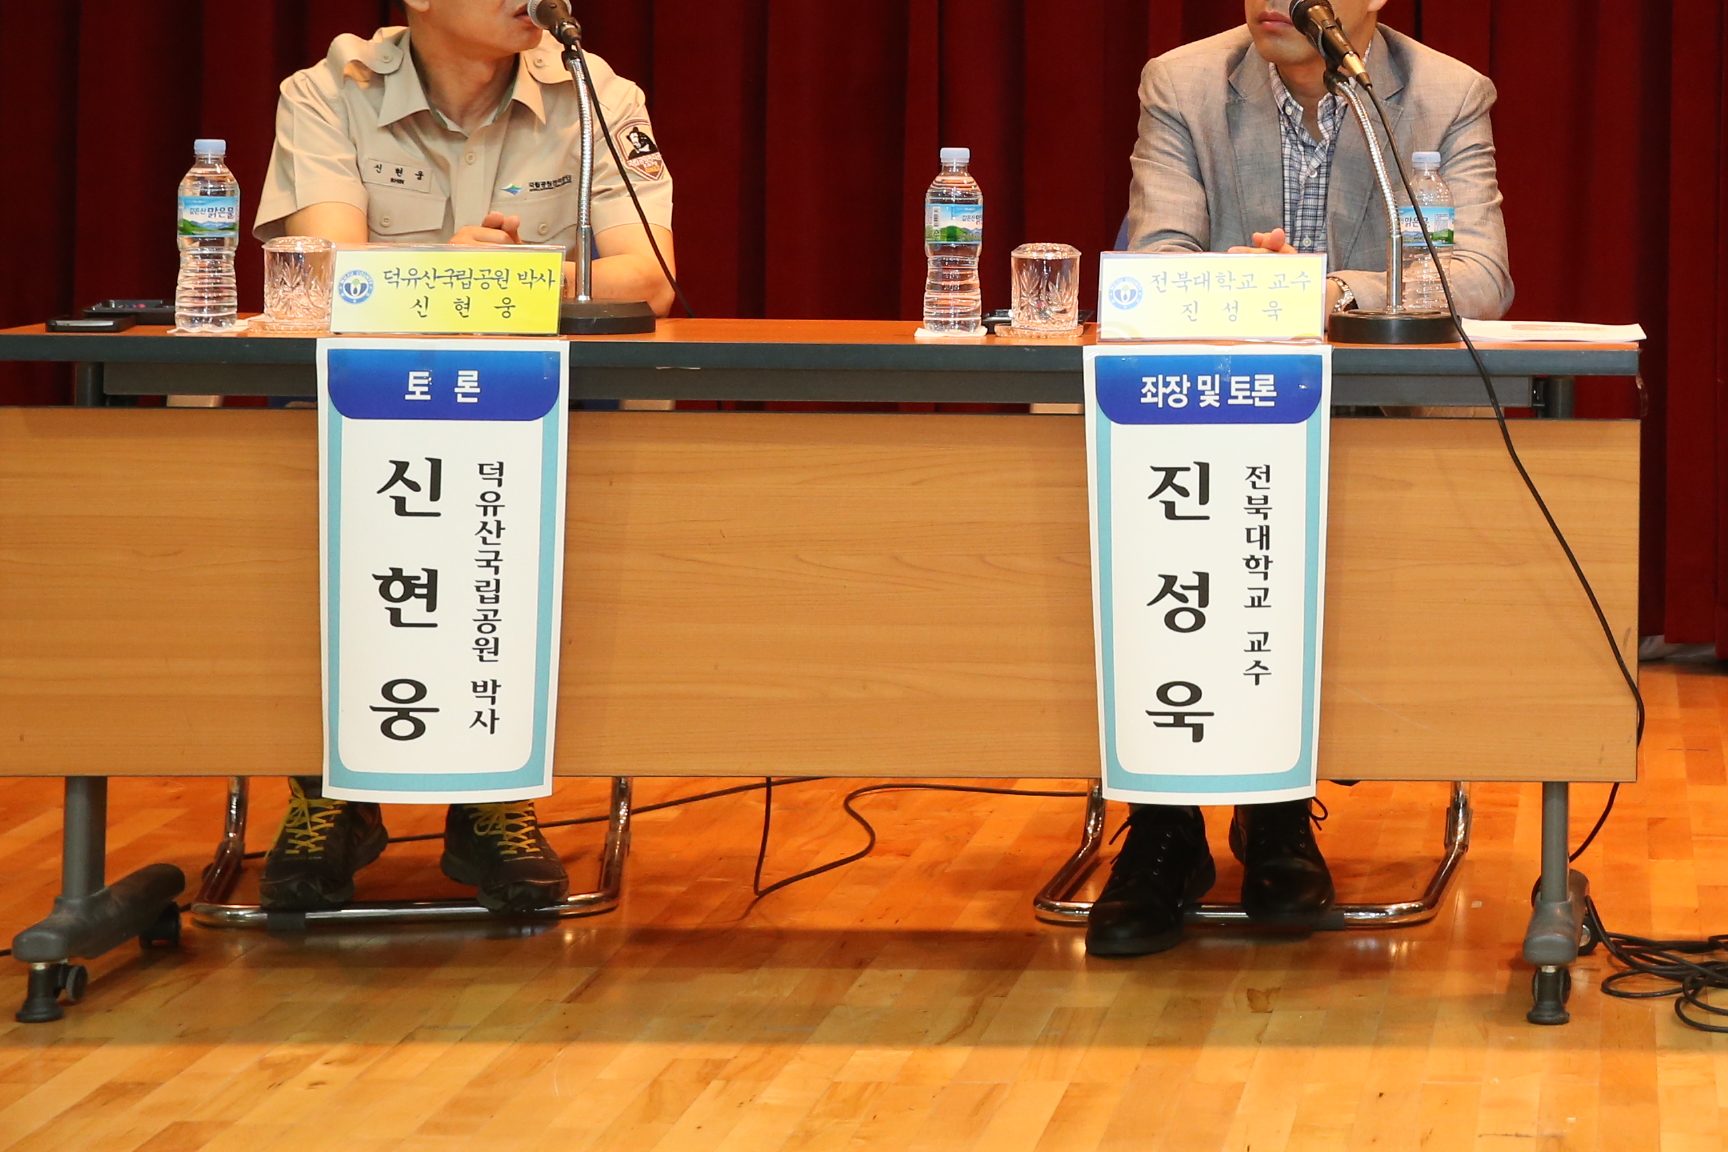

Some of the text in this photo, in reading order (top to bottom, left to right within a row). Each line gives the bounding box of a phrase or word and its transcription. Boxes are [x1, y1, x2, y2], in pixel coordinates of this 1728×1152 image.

[383, 268, 555, 290] 덕유산국립공원 박사
[1151, 271, 1257, 293] 전북대학교
[1268, 271, 1311, 291] 교수
[1141, 374, 1277, 408] 좌장 및 토론
[1243, 464, 1273, 686] 전북대학교 교수
[469, 461, 506, 734] 덕유산국립공원 박사
